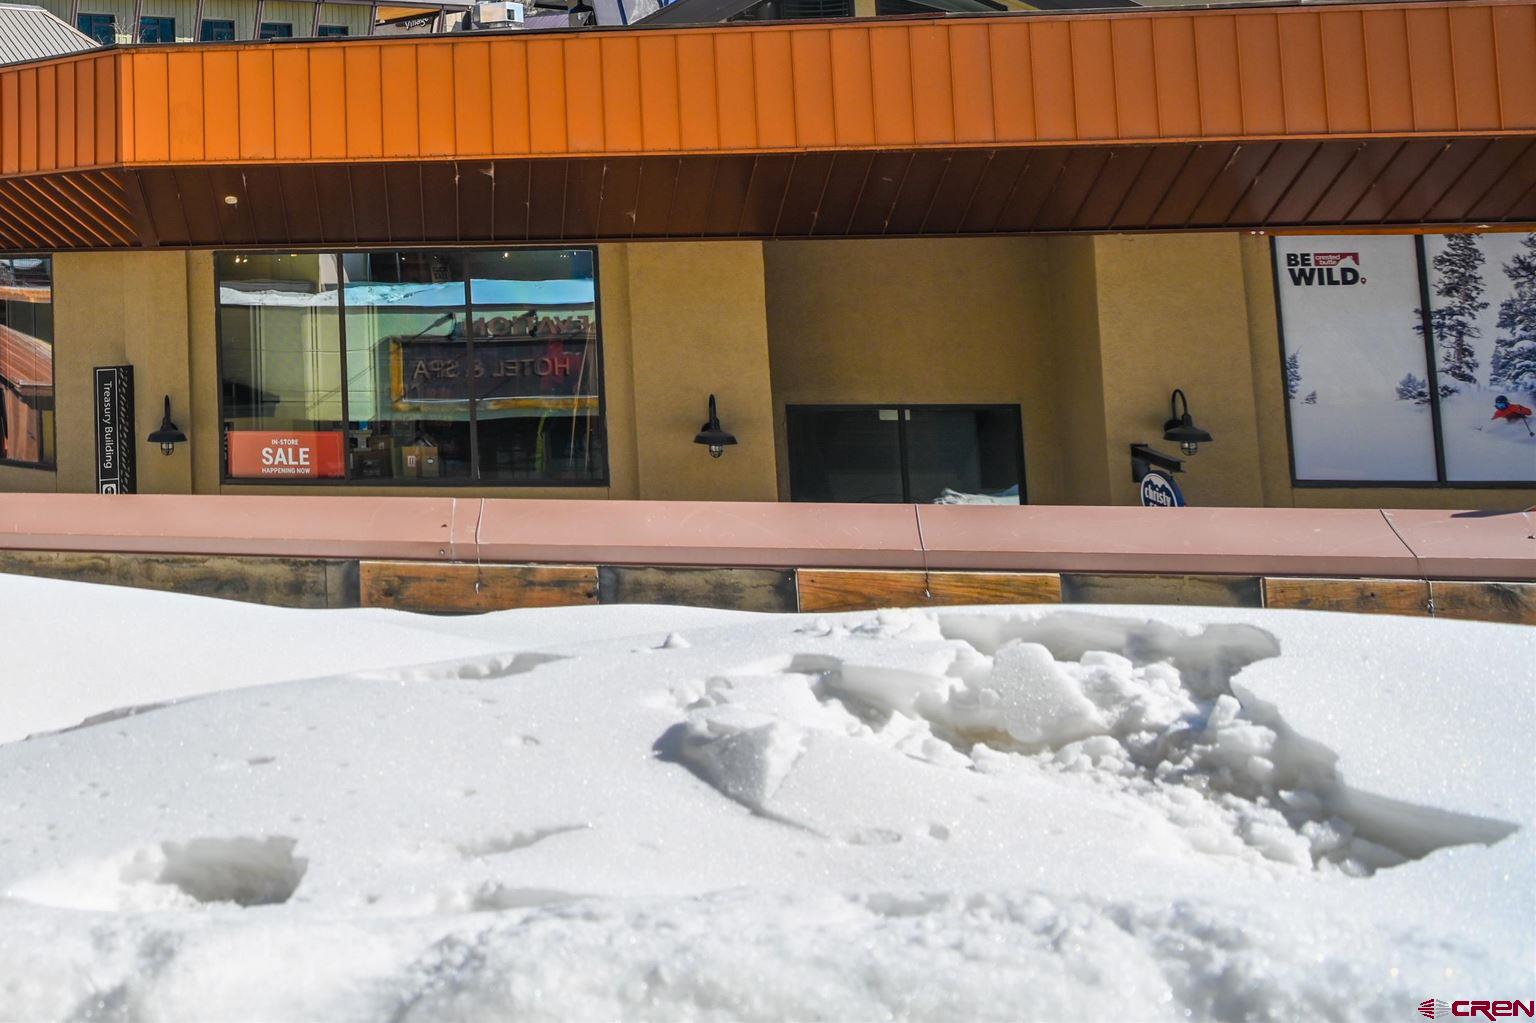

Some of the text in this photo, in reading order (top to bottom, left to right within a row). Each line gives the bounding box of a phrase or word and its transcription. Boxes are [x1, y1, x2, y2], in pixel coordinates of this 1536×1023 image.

[1286, 253, 1312, 267] BE
[102, 380, 114, 469] Treasury Building
[261, 447, 310, 465] SALE
